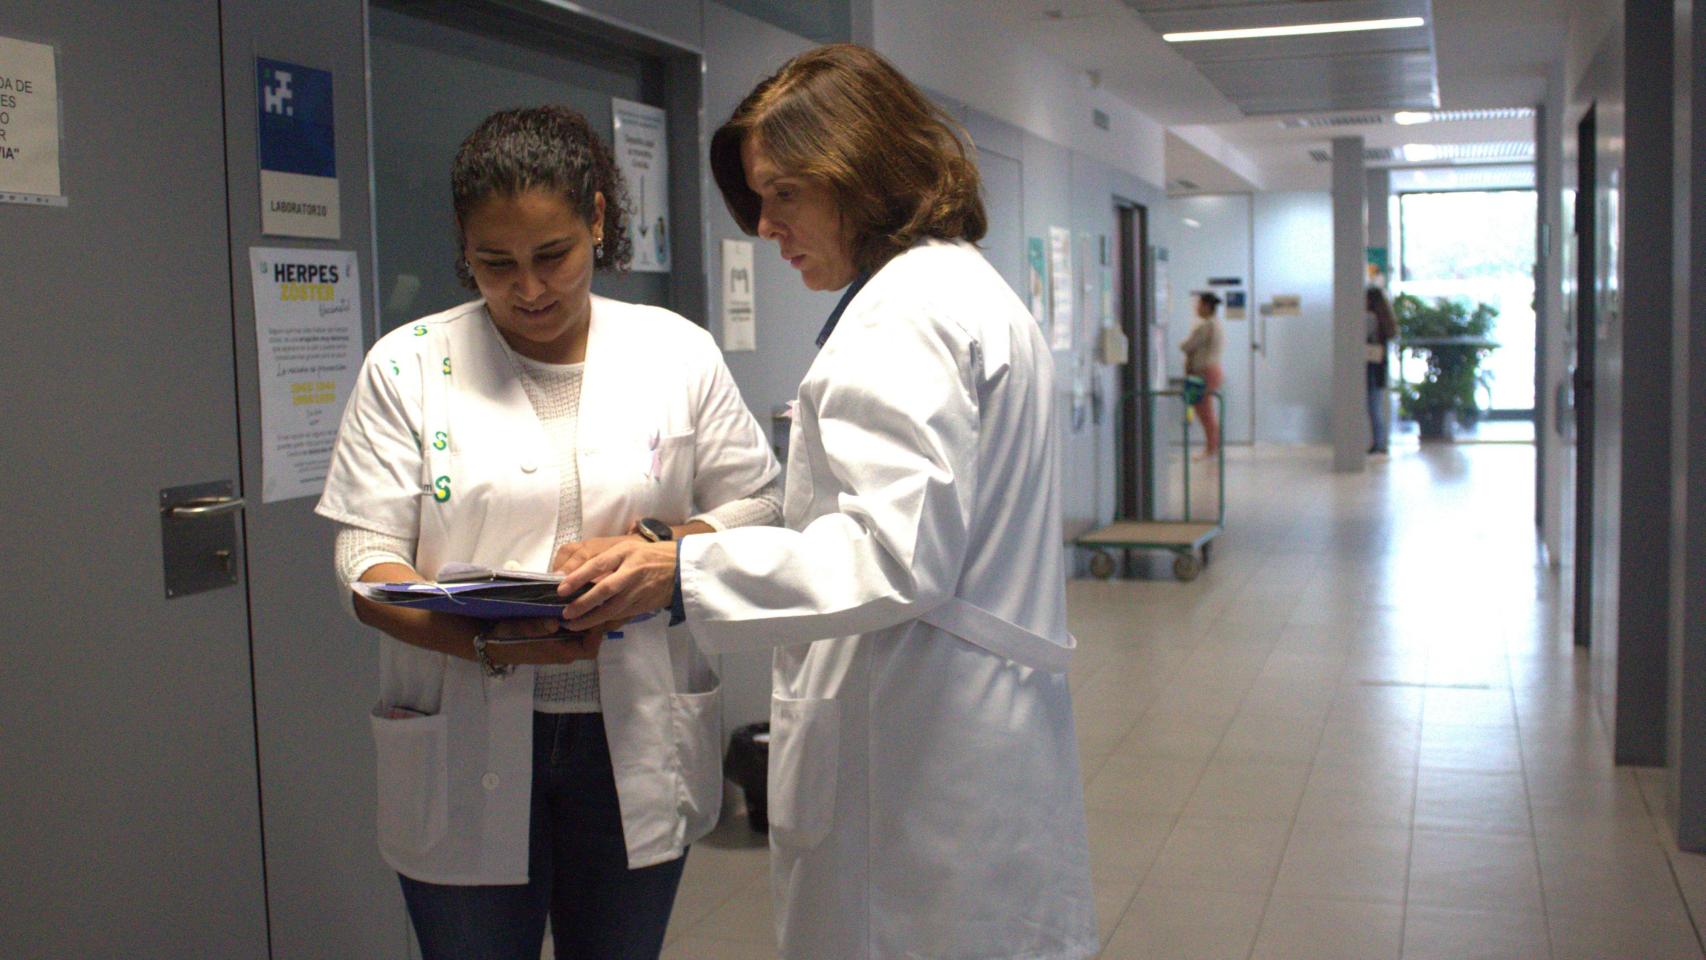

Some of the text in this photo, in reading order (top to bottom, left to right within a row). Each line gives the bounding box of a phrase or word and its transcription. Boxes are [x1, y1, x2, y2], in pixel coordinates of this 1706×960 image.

[15, 79, 33, 94] DE
[270, 200, 328, 217] LABORATORIO
[274, 263, 339, 283] HERPES
